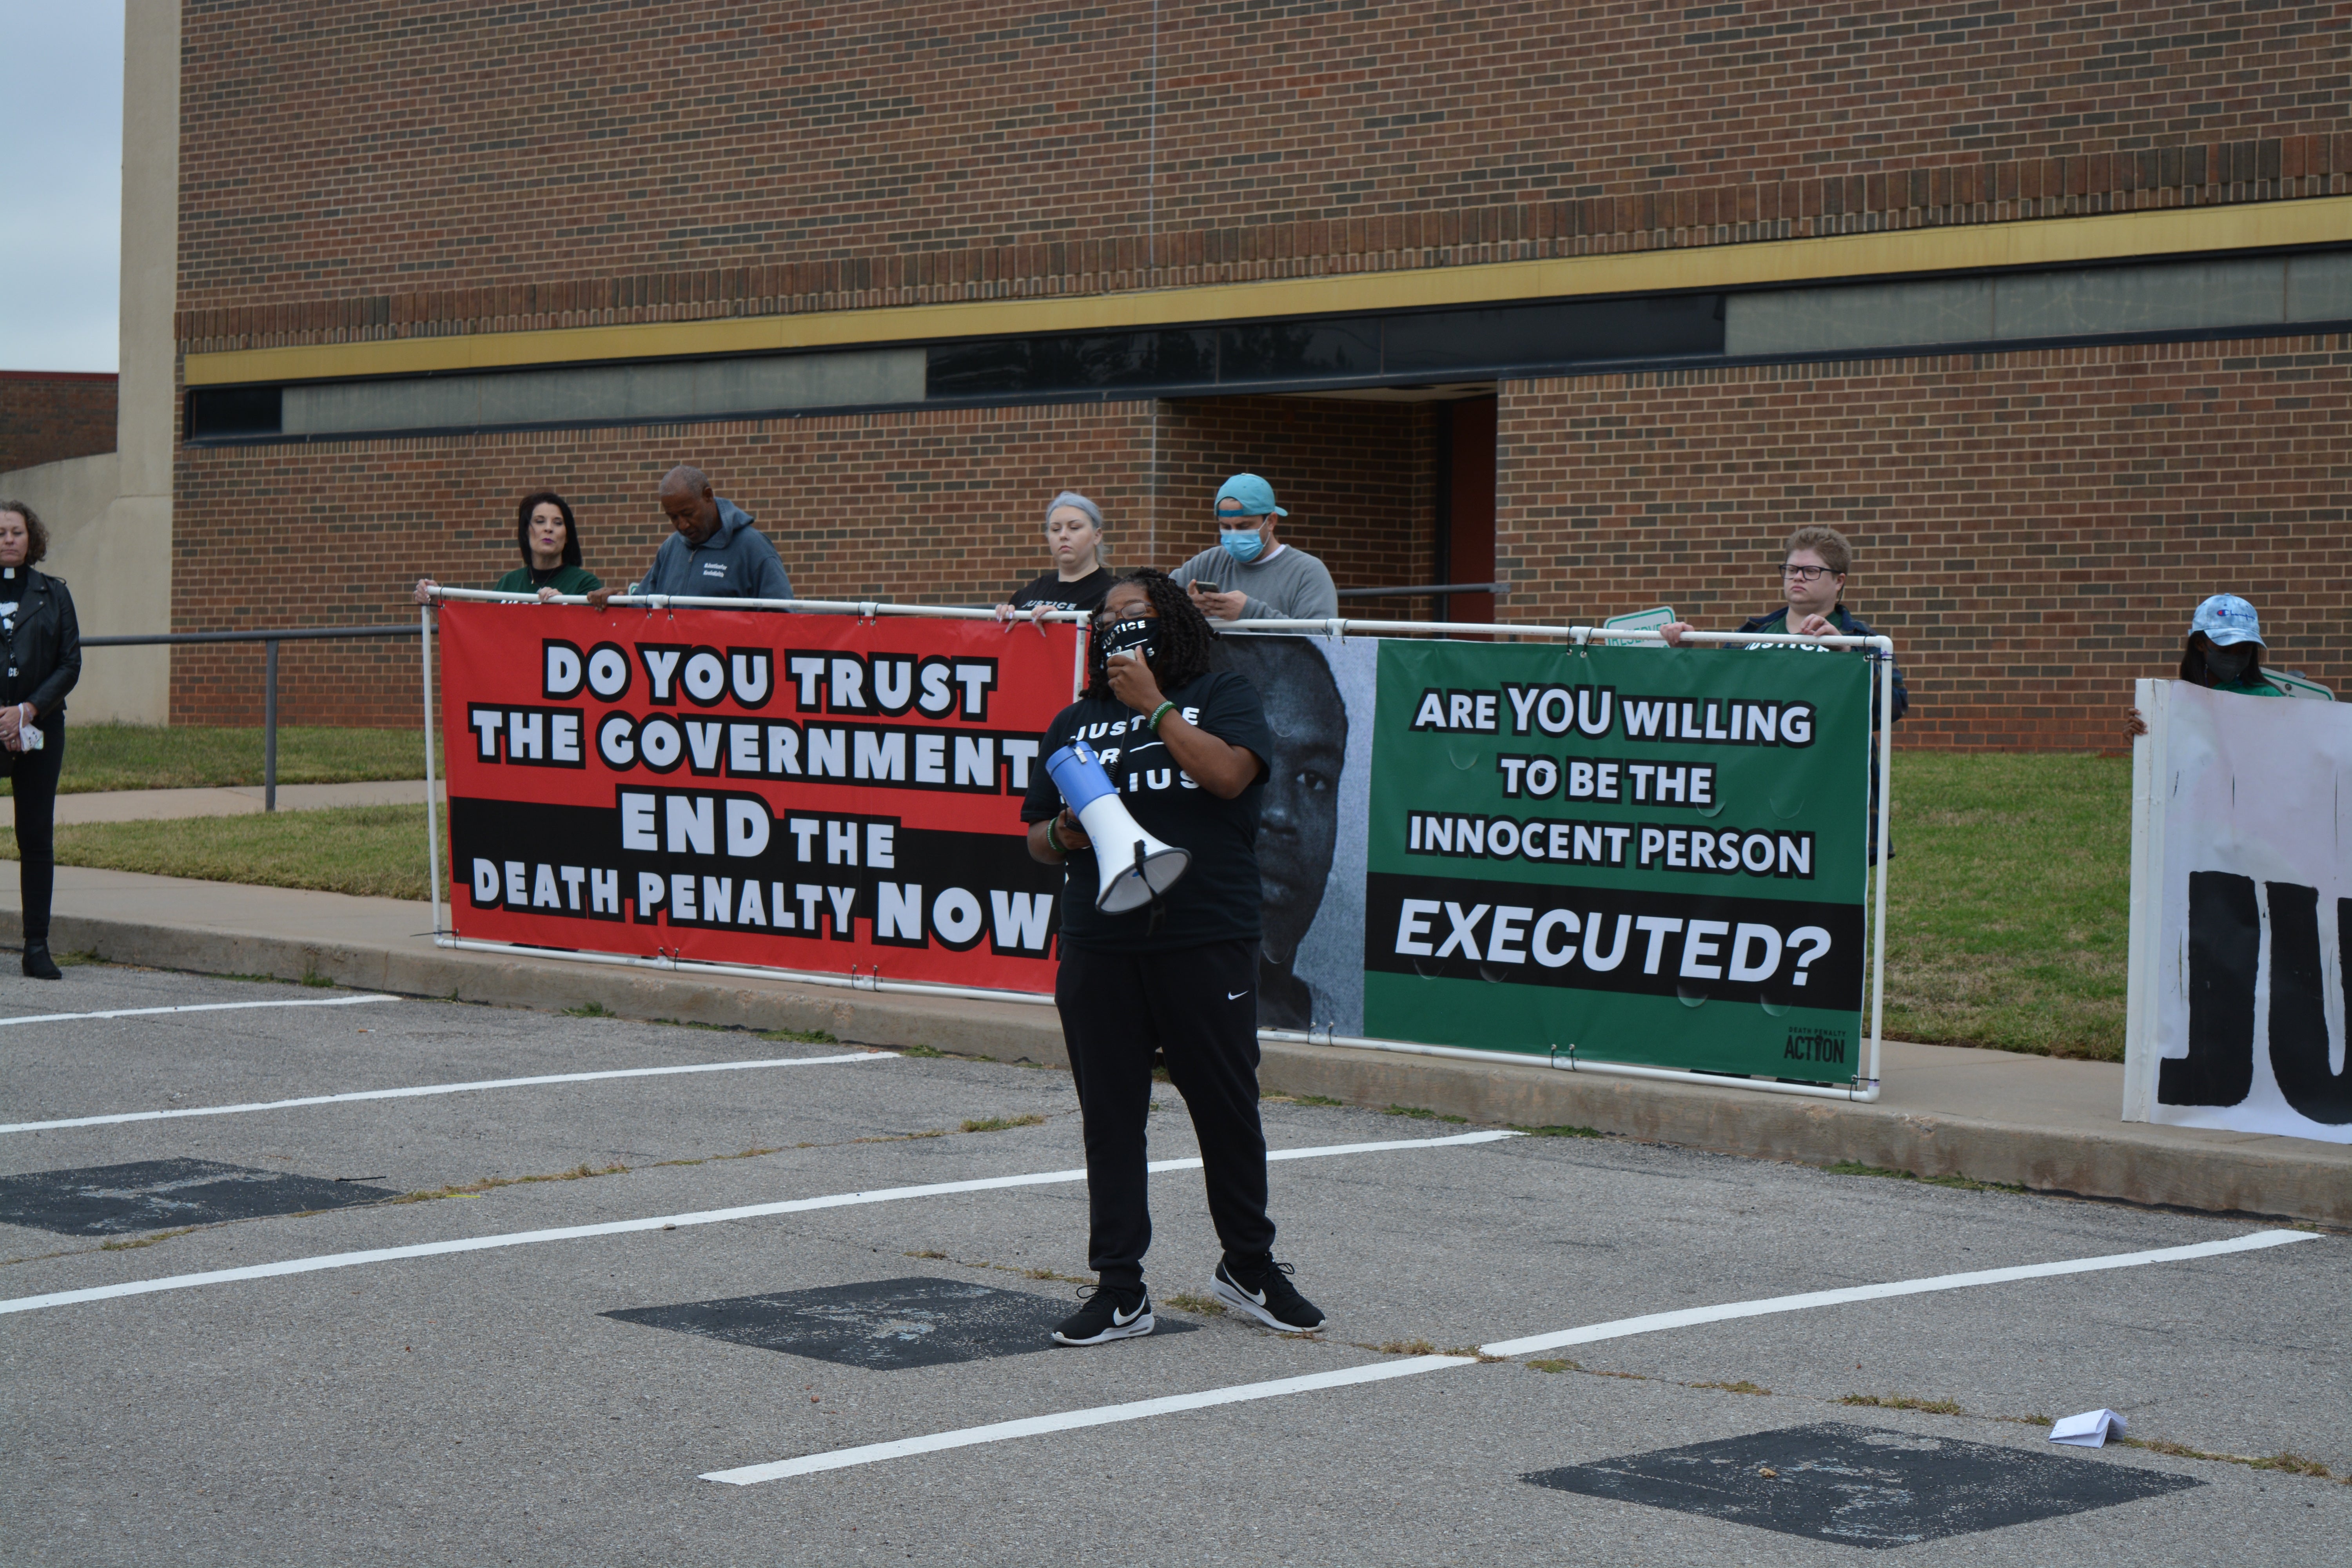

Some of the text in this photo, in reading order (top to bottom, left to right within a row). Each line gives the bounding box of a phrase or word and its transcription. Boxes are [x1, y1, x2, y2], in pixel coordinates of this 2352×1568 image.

[1021, 600, 1077, 611] JUSTICE
[1102, 620, 1146, 650] JUSTICE
[548, 646, 991, 713] DO YOU TRUST
[1070, 706, 1200, 741] JUSTE
[1415, 688, 1811, 743] ARE YOU WILLING
[473, 710, 1039, 788] THE GOVERNMENT
[1501, 758, 1712, 803] TO BE THE
[622, 792, 895, 869] END THE
[1409, 816, 1810, 874] INNOCENT PERSON
[473, 858, 619, 914] DEATH
[639, 871, 856, 933] PENALTY
[1395, 898, 1831, 986] EXECUTED?
[1784, 1035, 1845, 1063] ACTION
[1814, 1029, 1846, 1037] PENALTY
